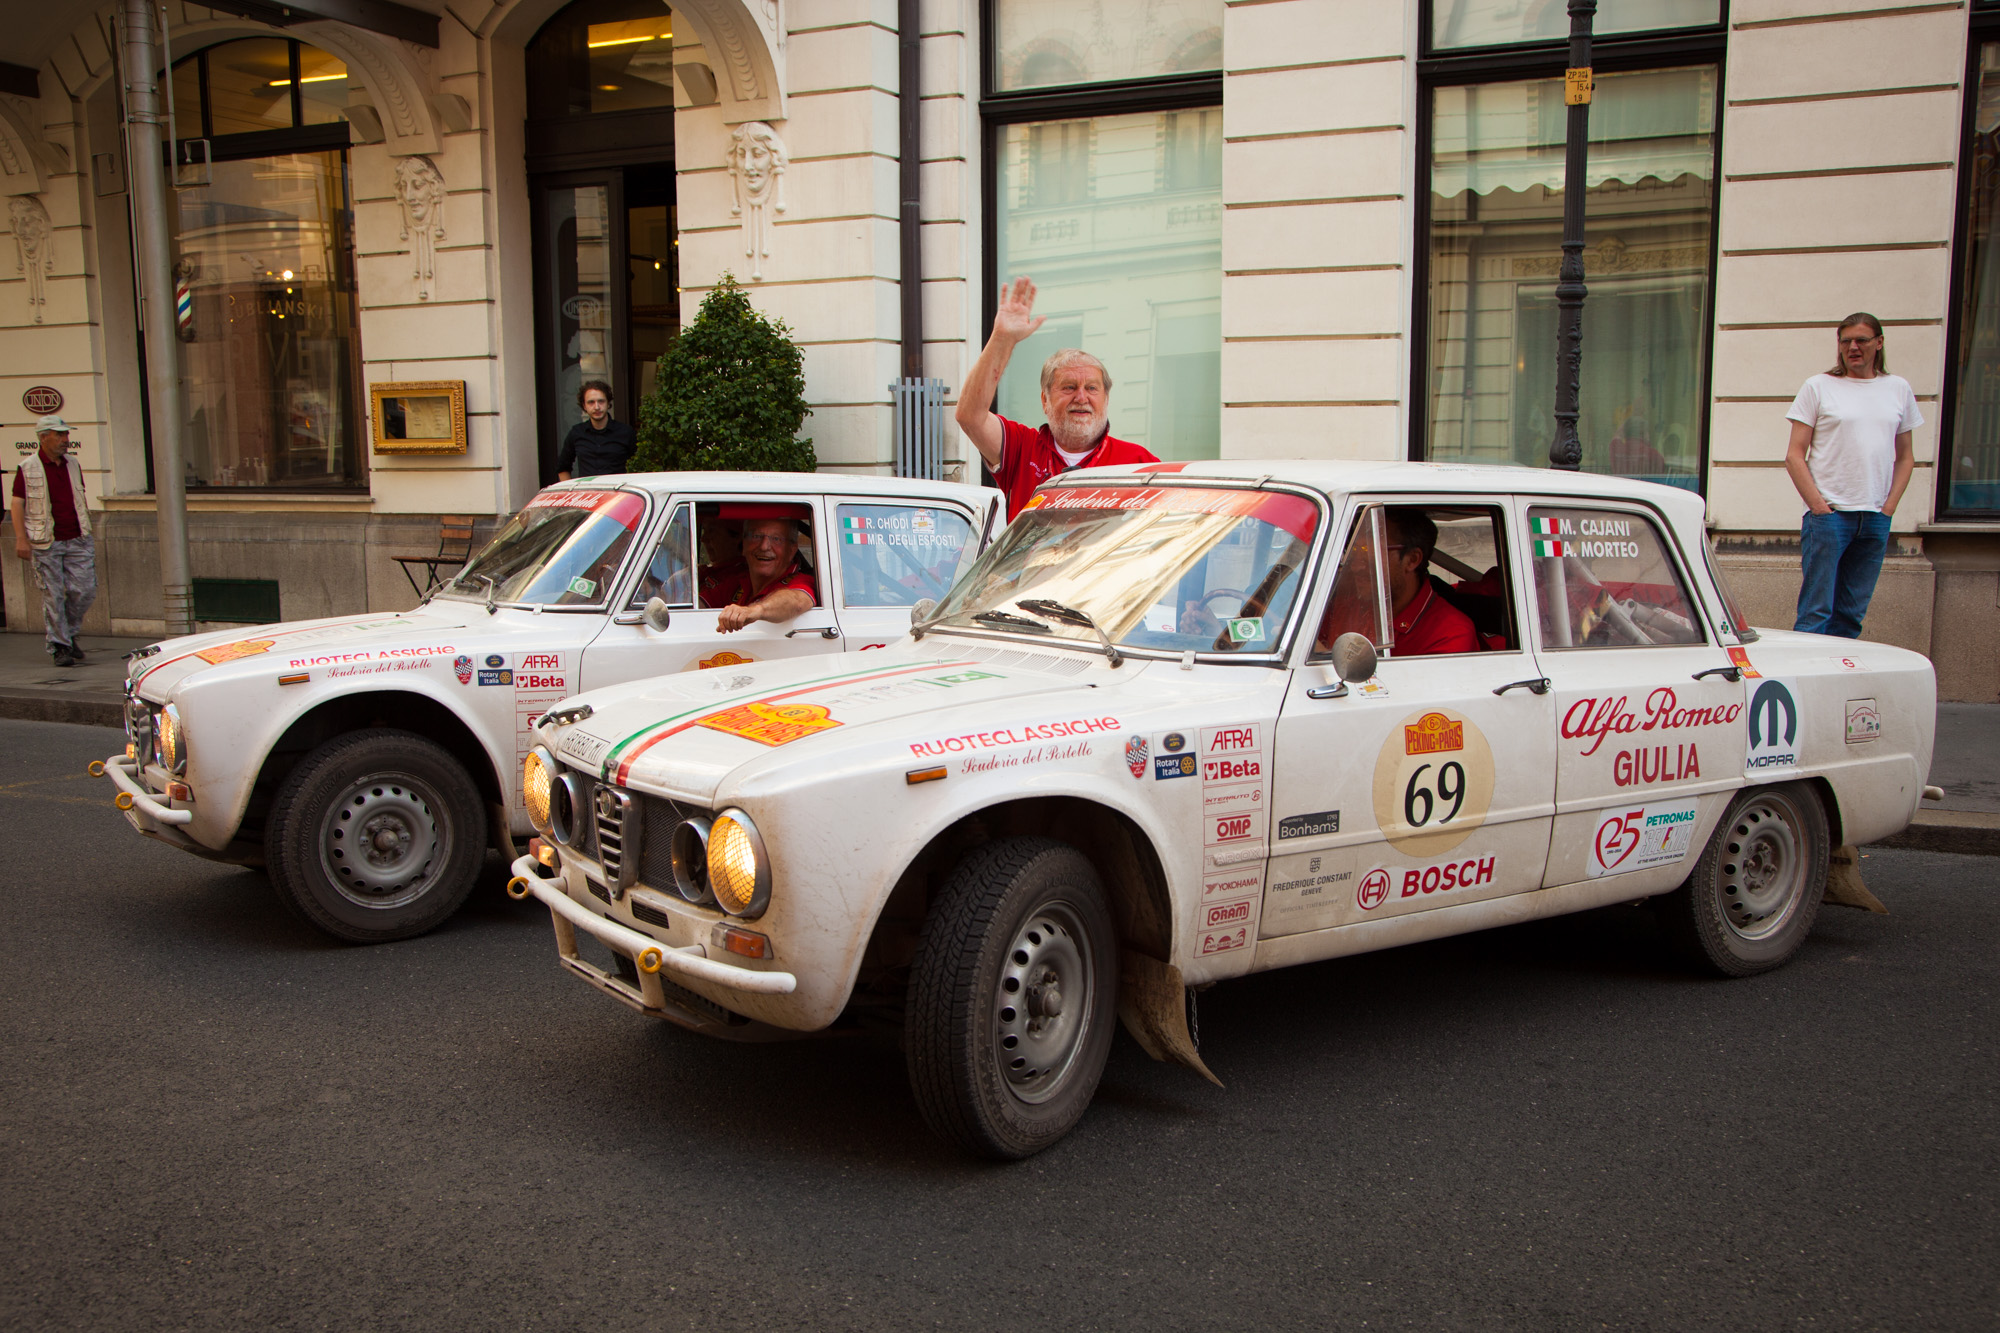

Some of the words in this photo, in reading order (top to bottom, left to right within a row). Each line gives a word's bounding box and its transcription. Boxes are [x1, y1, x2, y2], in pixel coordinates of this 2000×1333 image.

[25, 394, 60, 406] UNION
[15, 441, 39, 450] GRAND
[1046, 490, 1118, 509] Scuderia
[1119, 489, 1165, 509] del
[865, 517, 876, 530] R.
[877, 517, 909, 530] CHIODI
[1559, 518, 1577, 535] M.
[1580, 519, 1631, 536] CAJANI
[867, 533, 887, 545] M.R.
[889, 533, 917, 546] DEGLI
[918, 534, 956, 546] ESPOSTI
[1562, 541, 1578, 557] A.
[1581, 541, 1639, 558] MORTEO
[327, 665, 372, 678] Scuderia
[375, 662, 392, 673] del
[393, 659, 432, 671] Portello
[521, 655, 559, 669] AFRA
[479, 671, 499, 679] Rotary
[529, 675, 565, 688] Beta
[1561, 695, 1641, 757] Alfa
[1641, 686, 1744, 731] Romeo
[1210, 728, 1254, 751] AFRA
[1407, 729, 1436, 752] PEKING
[1438, 724, 1462, 750] PARIS
[961, 754, 1019, 775] Scuderia
[1022, 748, 1043, 764] del
[1045, 741, 1094, 762] Portello
[1156, 759, 1180, 768] Rotary
[1613, 742, 1701, 787] GIULIA
[1746, 753, 1795, 769] MOPAR
[1162, 767, 1180, 776] Italia
[1219, 760, 1261, 779] Beta
[1404, 760, 1466, 828] 69
[1645, 810, 1696, 827] PETRONAS
[1216, 818, 1251, 838] OMP
[1281, 822, 1337, 838] Bonhams
[1218, 877, 1258, 891] YOKOHAMA
[1272, 877, 1316, 892] FREDERIQUE
[1317, 871, 1353, 885] CONSTANT
[1401, 856, 1496, 898] BOSCH
[1300, 886, 1323, 897] GENEVE
[1210, 905, 1247, 922] ORAM
